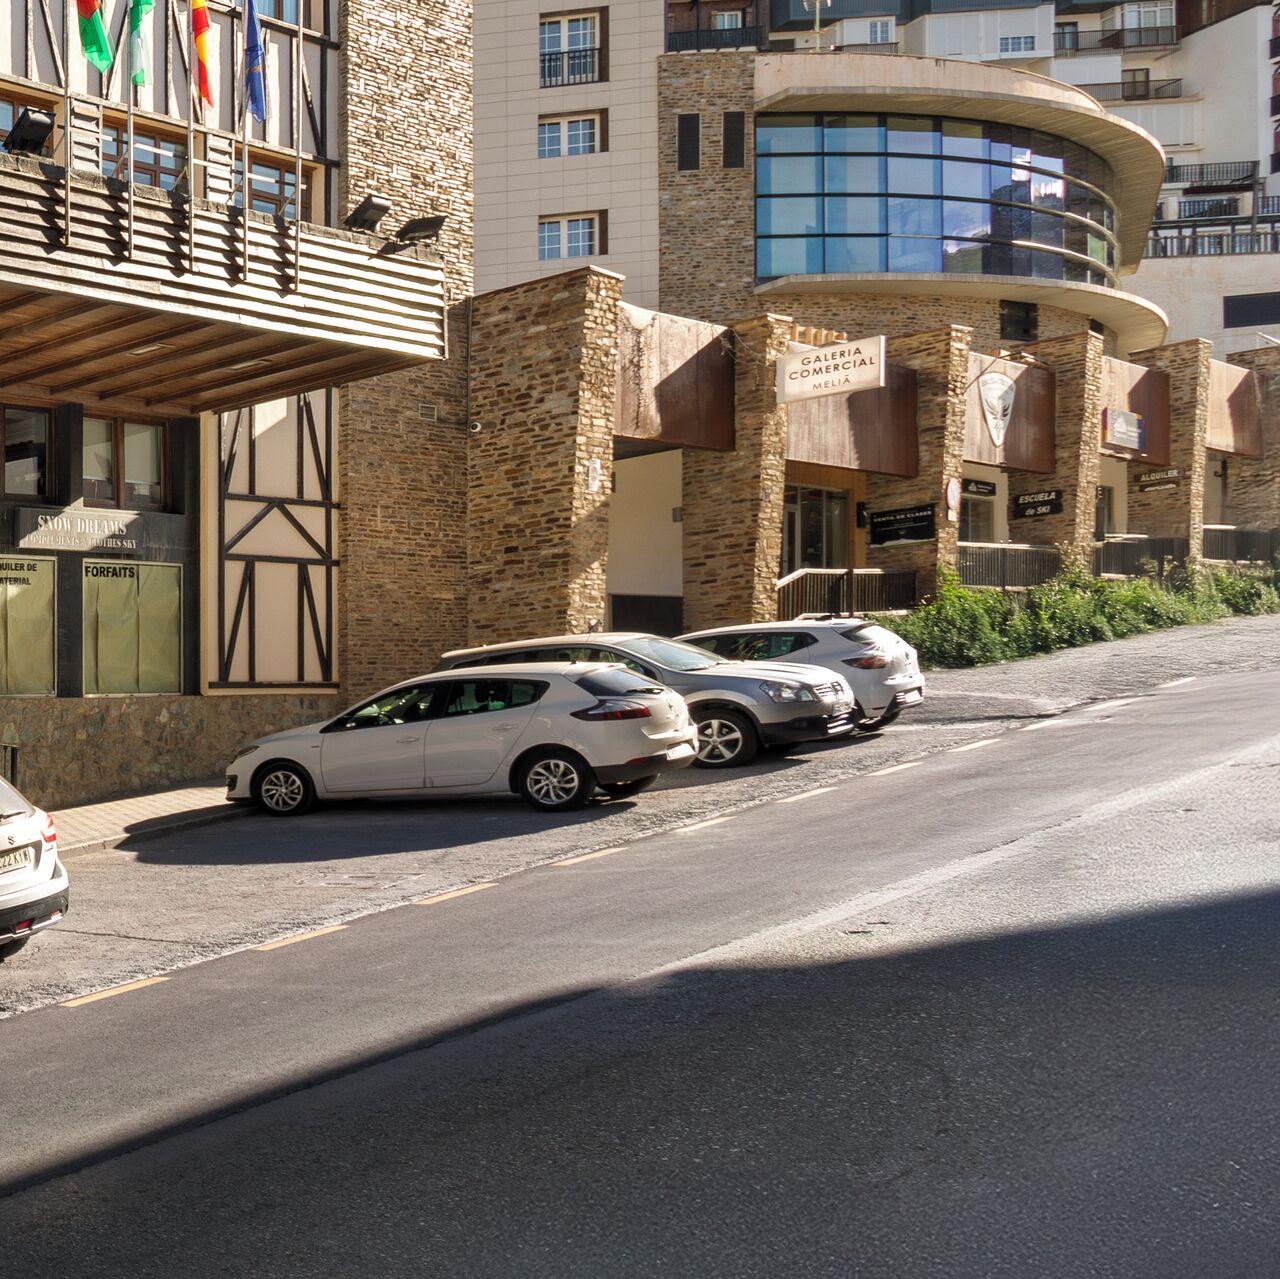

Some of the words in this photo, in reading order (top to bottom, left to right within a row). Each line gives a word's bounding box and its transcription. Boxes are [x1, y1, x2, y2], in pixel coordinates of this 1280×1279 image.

[801, 347, 862, 366] GALERIA
[789, 357, 875, 380] COMERCIAL
[1140, 469, 1178, 481] ALQUILER
[1019, 491, 1056, 504] ESCUELA
[1036, 505, 1050, 514] SKI
[37, 514, 72, 531] SNOW
[77, 518, 128, 536] DREAMS
[123, 539, 137, 549] SKY
[27, 563, 37, 572] DE
[85, 565, 135, 578] FORFAITS
